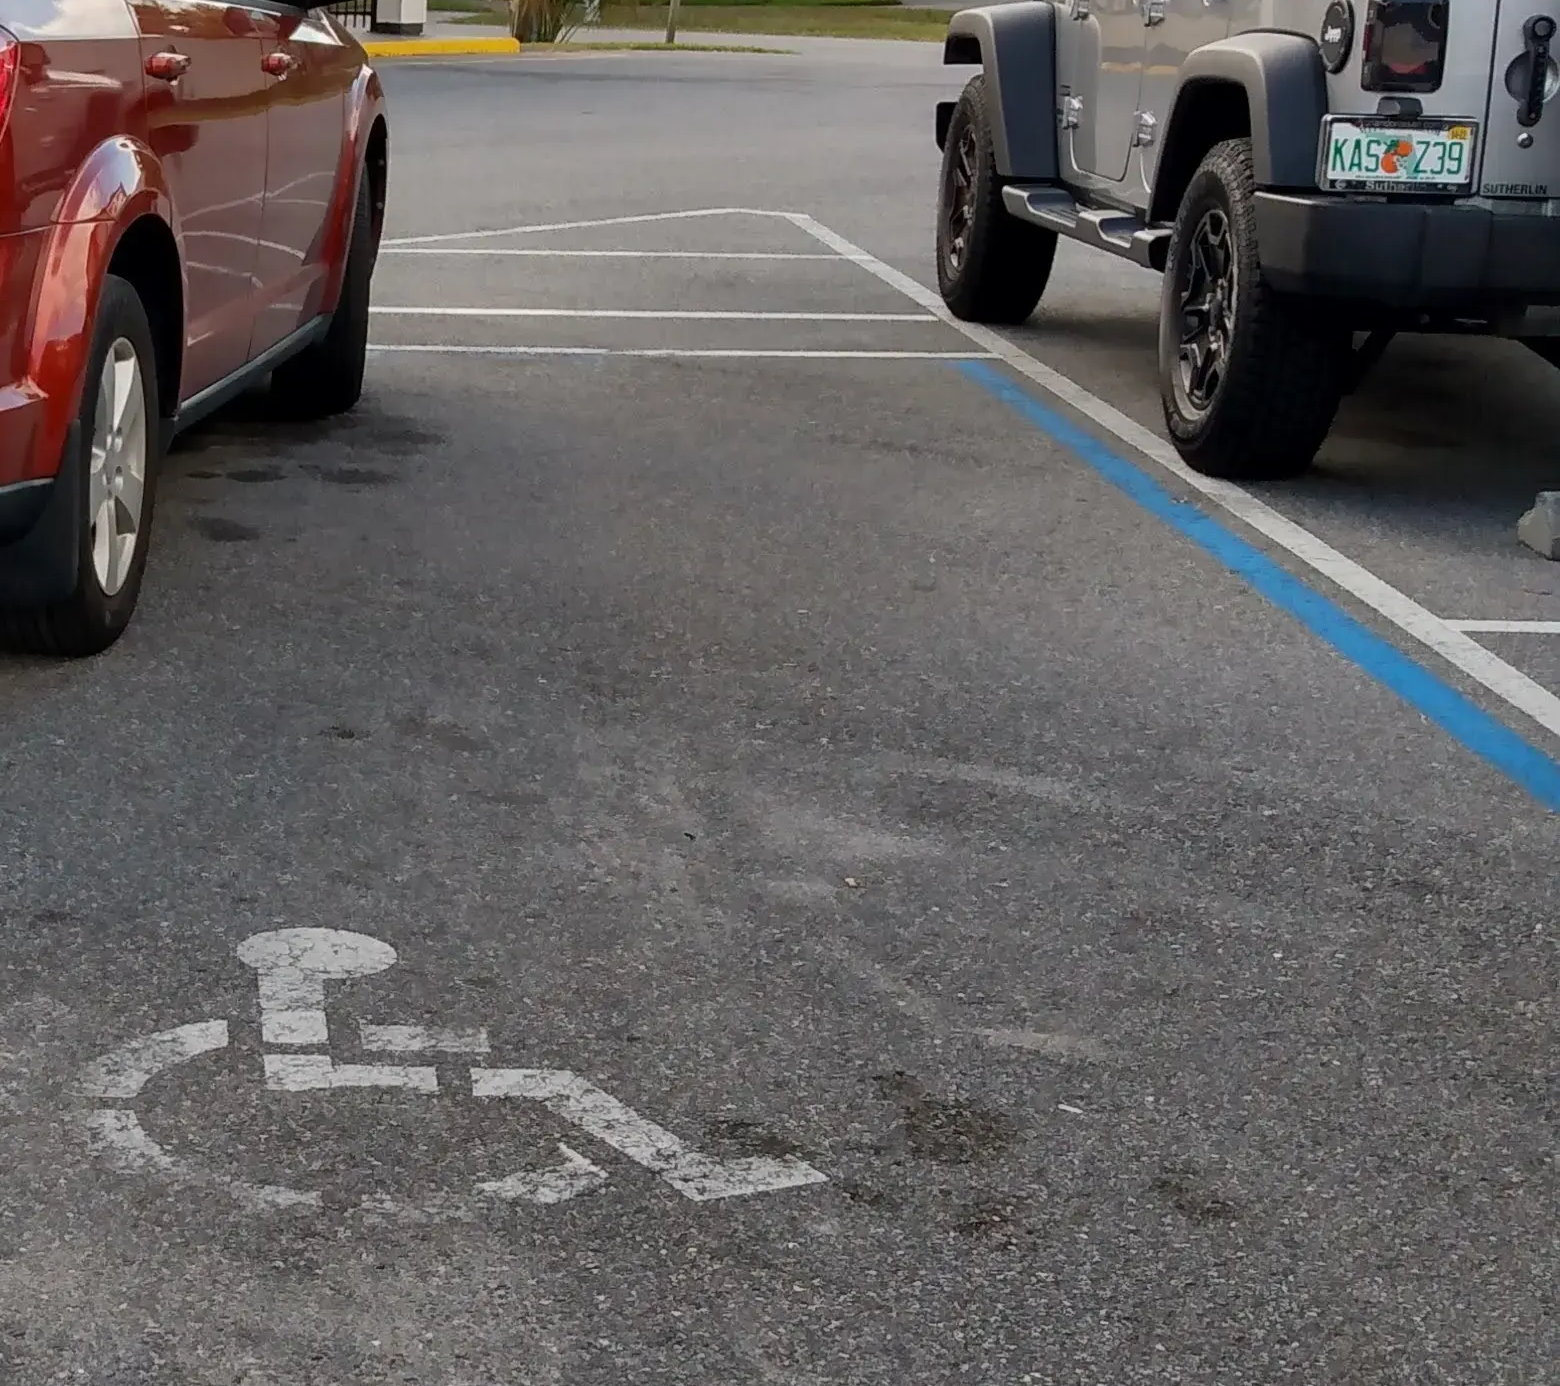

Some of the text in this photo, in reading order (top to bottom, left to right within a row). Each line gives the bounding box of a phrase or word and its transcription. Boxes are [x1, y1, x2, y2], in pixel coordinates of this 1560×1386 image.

[1331, 138, 1464, 175] KAS Z39
[1483, 184, 1548, 196] SUTHERLIN
